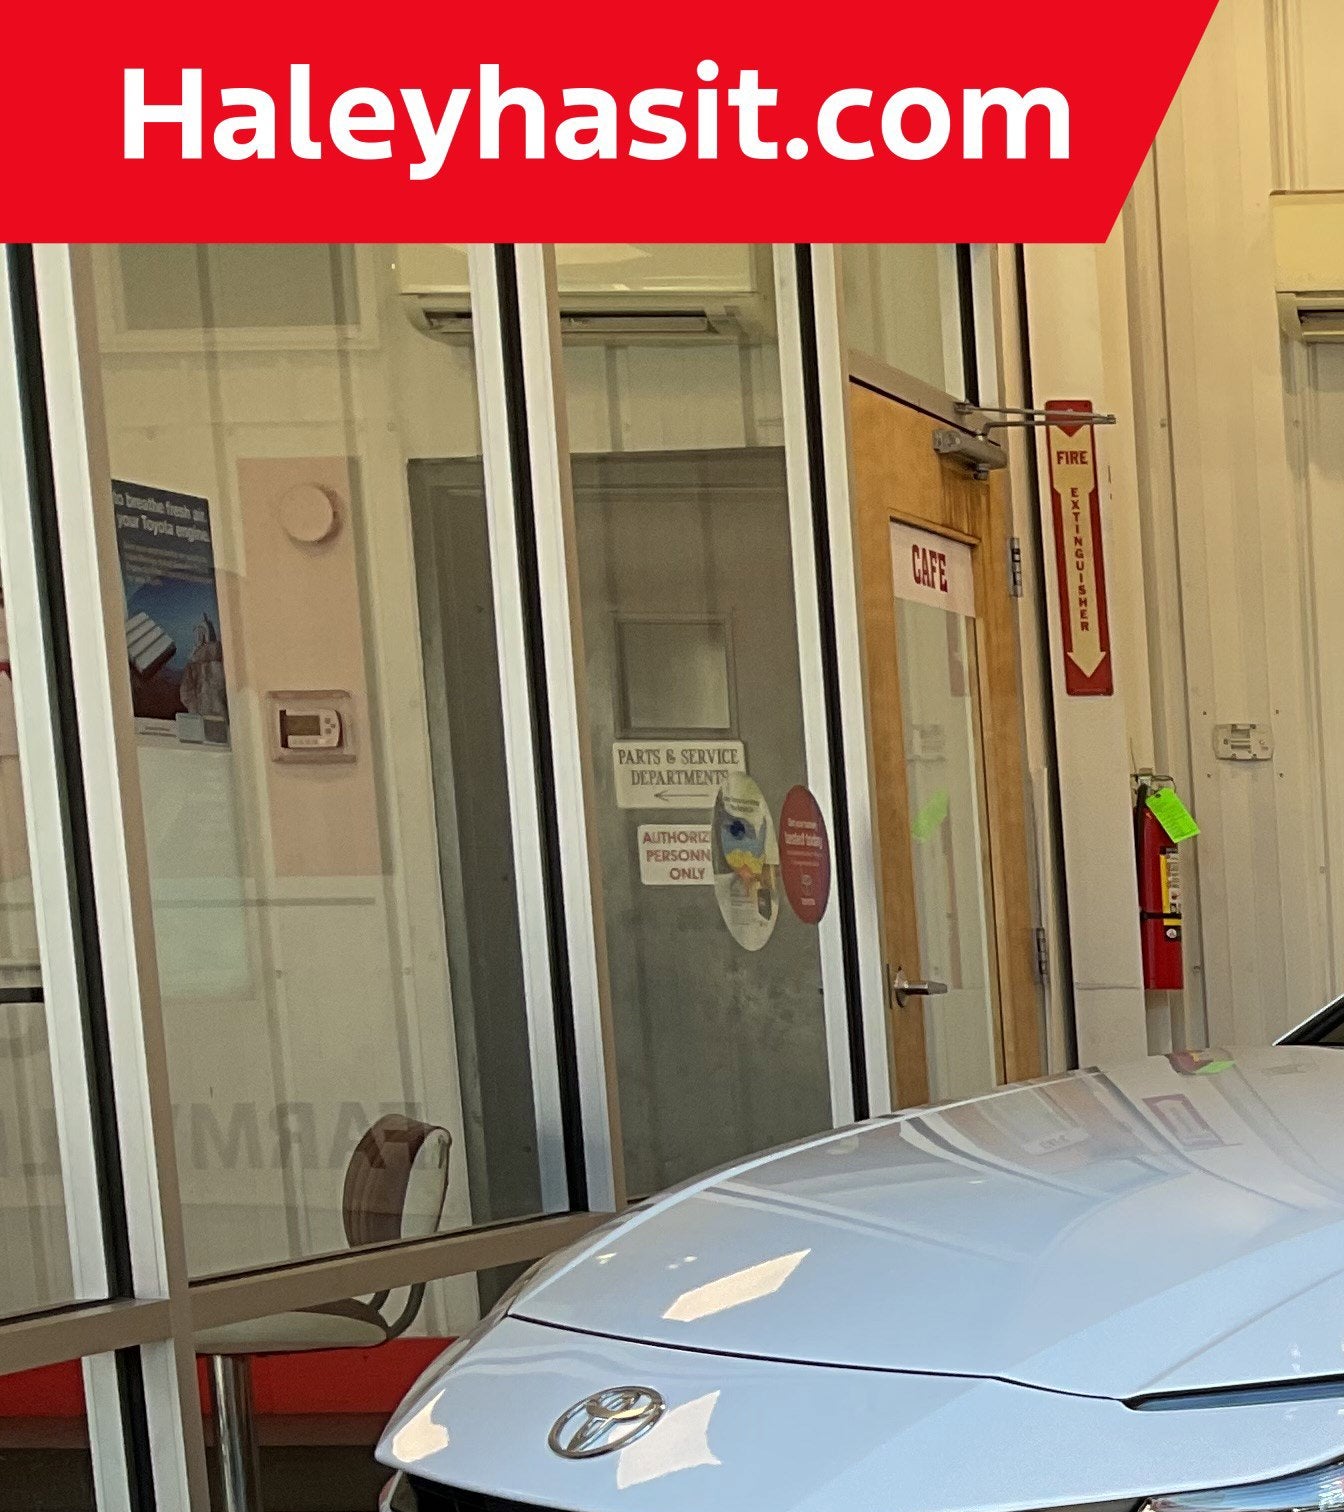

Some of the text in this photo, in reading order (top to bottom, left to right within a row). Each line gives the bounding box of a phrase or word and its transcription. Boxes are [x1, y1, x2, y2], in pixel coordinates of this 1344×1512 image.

[1056, 450, 1088, 465] FIRE
[141, 514, 174, 536] Toyota
[1070, 487, 1089, 632] EXTINGUISHER
[912, 544, 948, 592] CAFE
[618, 749, 739, 765] PARTS & SERVICE
[643, 830, 711, 845] AUTHORIZ
[646, 849, 711, 863] PERSONN
[669, 867, 705, 881] ONLY
